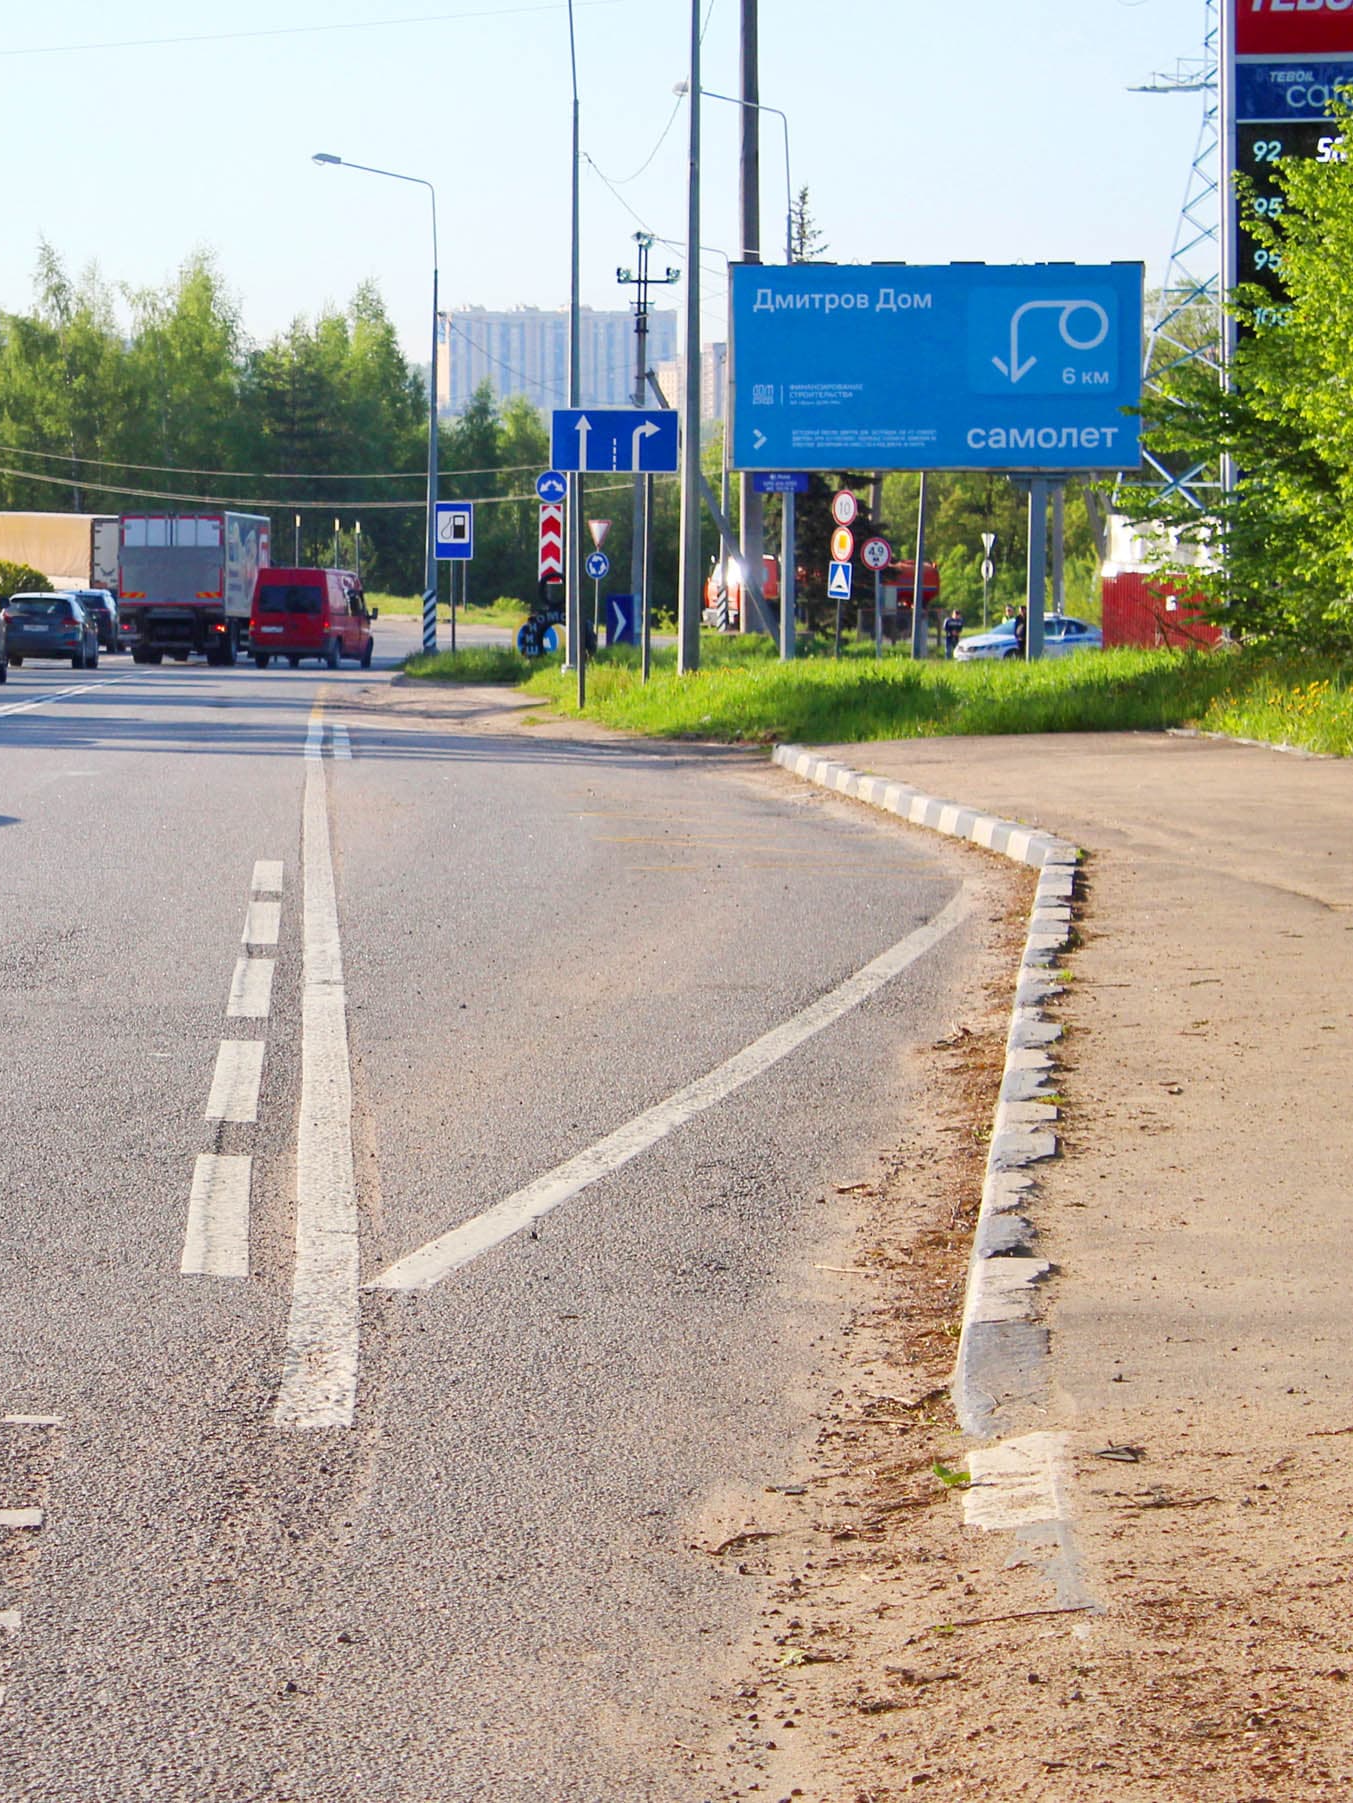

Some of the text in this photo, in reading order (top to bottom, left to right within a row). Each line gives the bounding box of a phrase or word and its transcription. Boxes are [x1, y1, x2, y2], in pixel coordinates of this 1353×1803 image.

[1269, 71, 1314, 82] TEBOIL
[1253, 141, 1281, 162] 92
[1254, 197, 1283, 218] 95
[1254, 250, 1282, 270] 95
[753, 288, 932, 313] Дмитров Дом
[1062, 367, 1109, 385] 6 км
[967, 427, 1119, 449] самолет
[840, 501, 851, 515] 10
